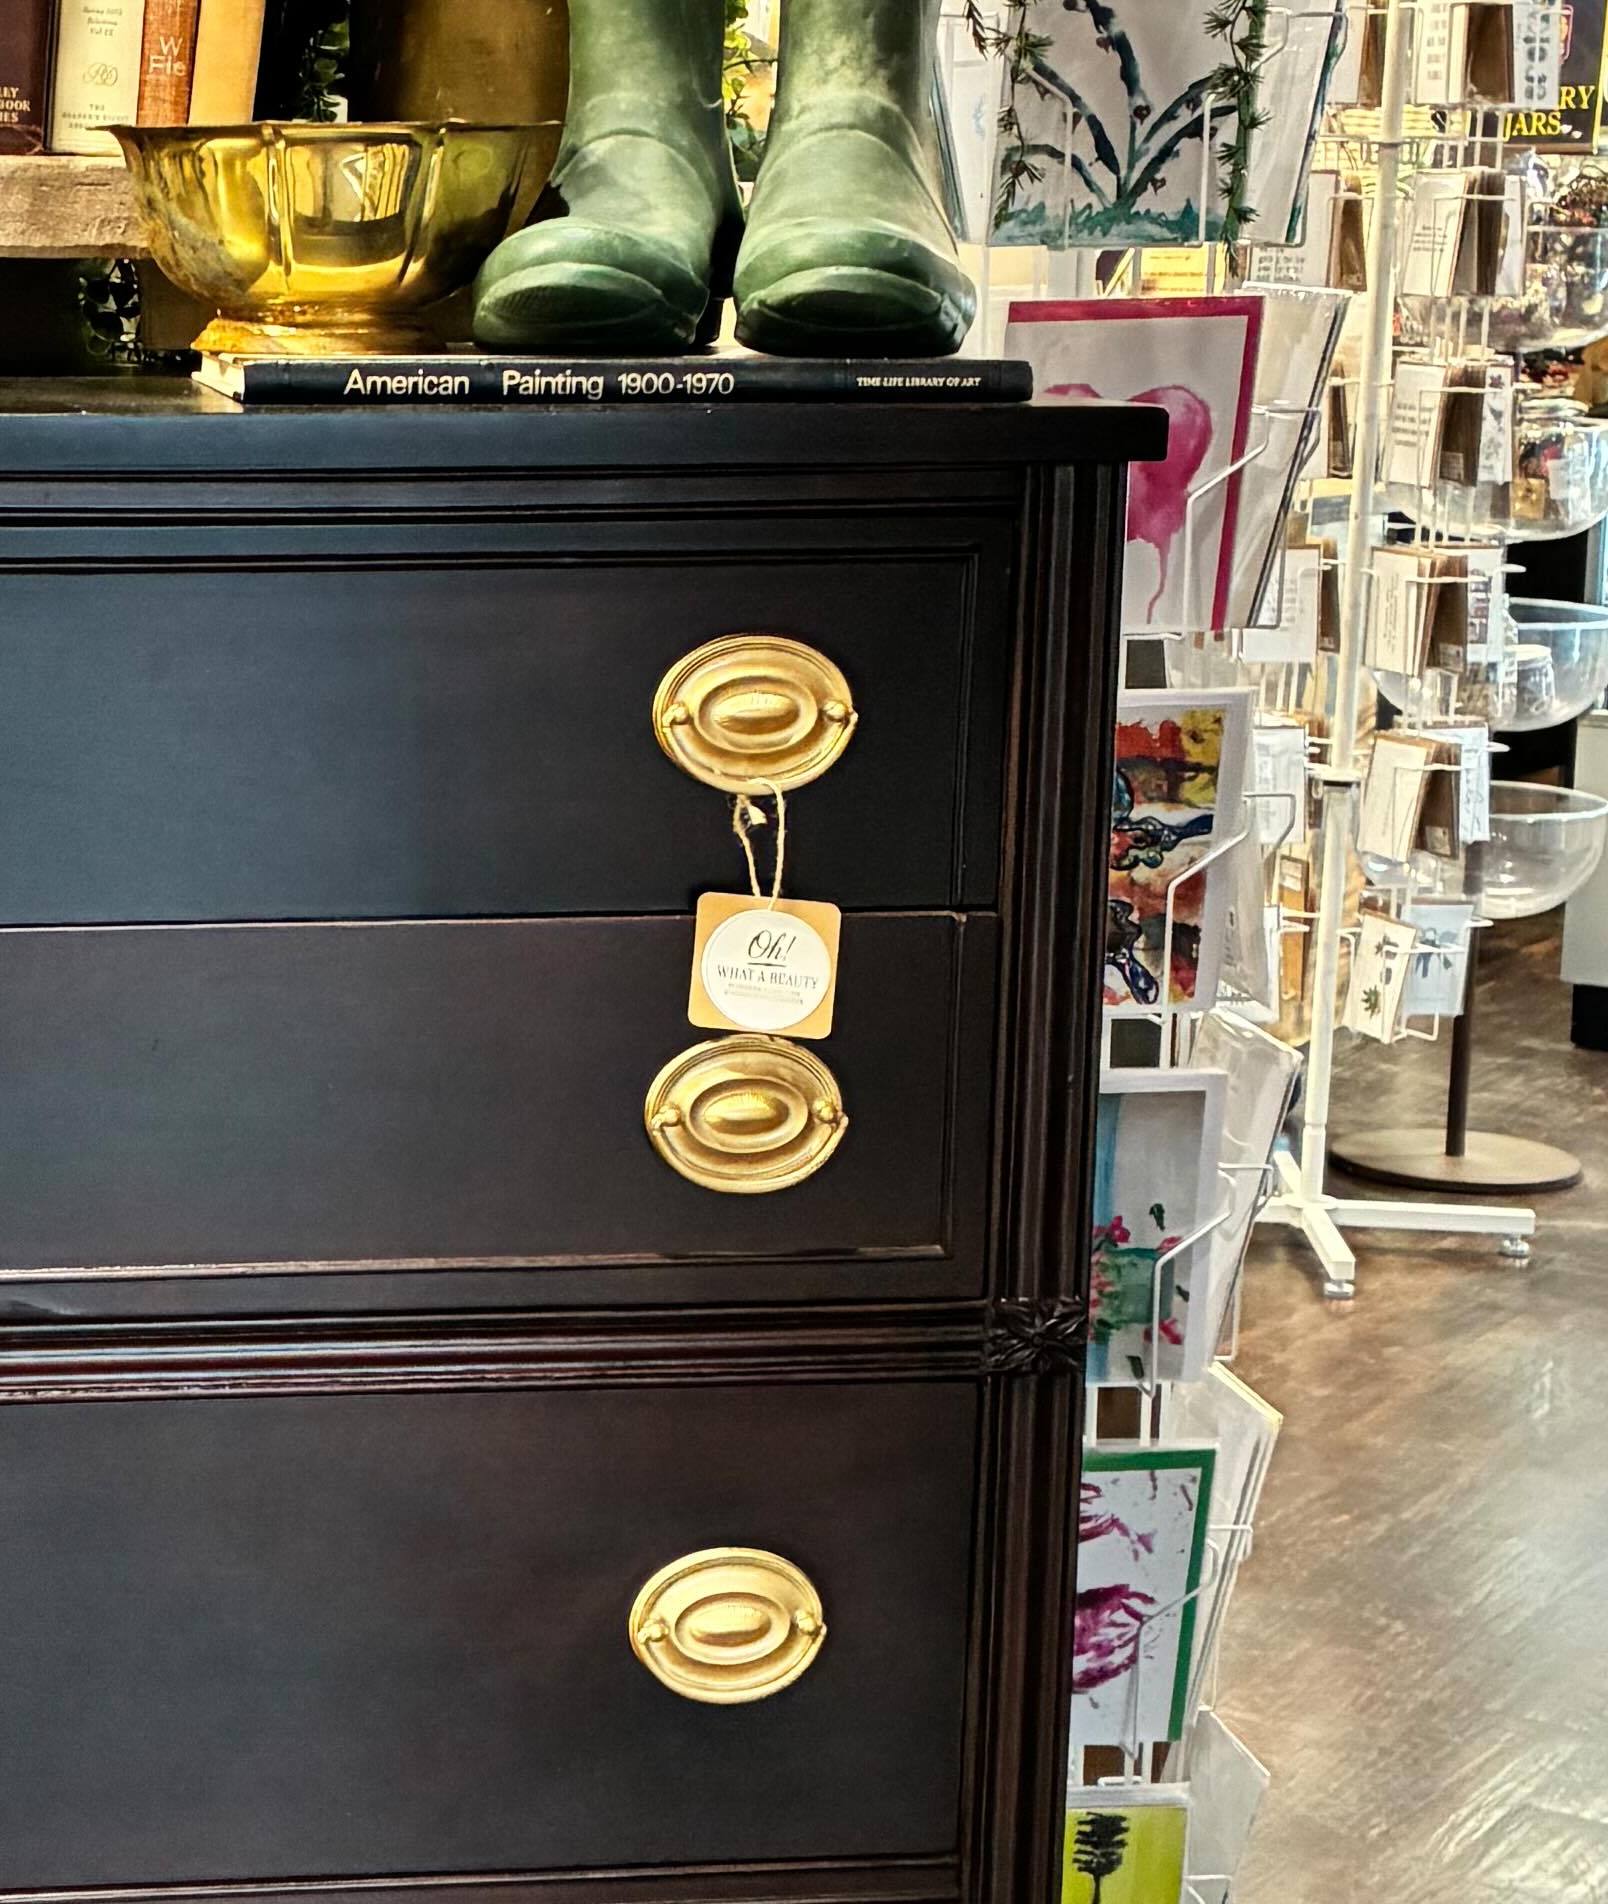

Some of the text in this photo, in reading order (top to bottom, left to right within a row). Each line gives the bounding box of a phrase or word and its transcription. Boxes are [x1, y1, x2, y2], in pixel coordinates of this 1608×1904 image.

[1559, 84, 1596, 110] RY
[1504, 111, 1562, 142] JARS
[342, 368, 735, 400] American Painting 1900-1970
[905, 377, 946, 387] LIBRARY
[946, 377, 960, 387] OF
[960, 377, 982, 387] ART
[717, 964, 755, 981] WHAT
[757, 970, 766, 983] A
[769, 971, 820, 990] BEAUTY
